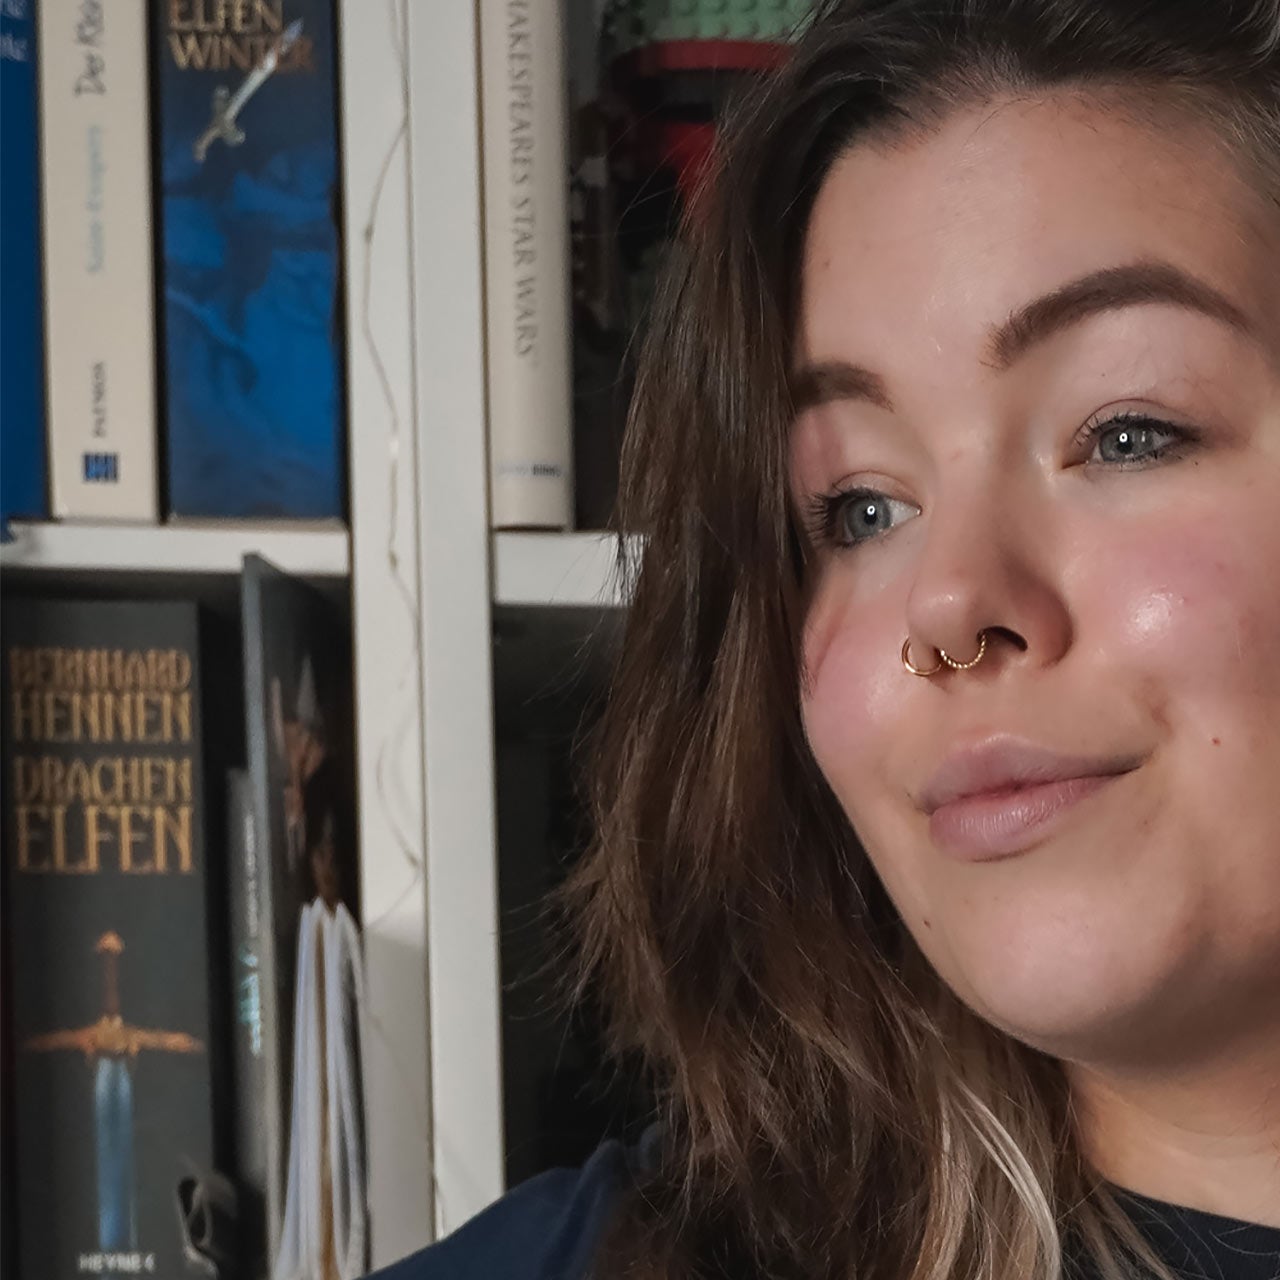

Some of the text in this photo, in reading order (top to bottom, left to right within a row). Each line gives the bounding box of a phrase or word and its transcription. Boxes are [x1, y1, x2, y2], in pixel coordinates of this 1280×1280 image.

[511, 198, 538, 268] STAR
[514, 276, 539, 358] WARS
[10, 648, 192, 692] BERNHARD
[13, 691, 192, 744] HENNEN
[14, 755, 193, 801] DRACHEN
[17, 803, 194, 876] ELFEN
